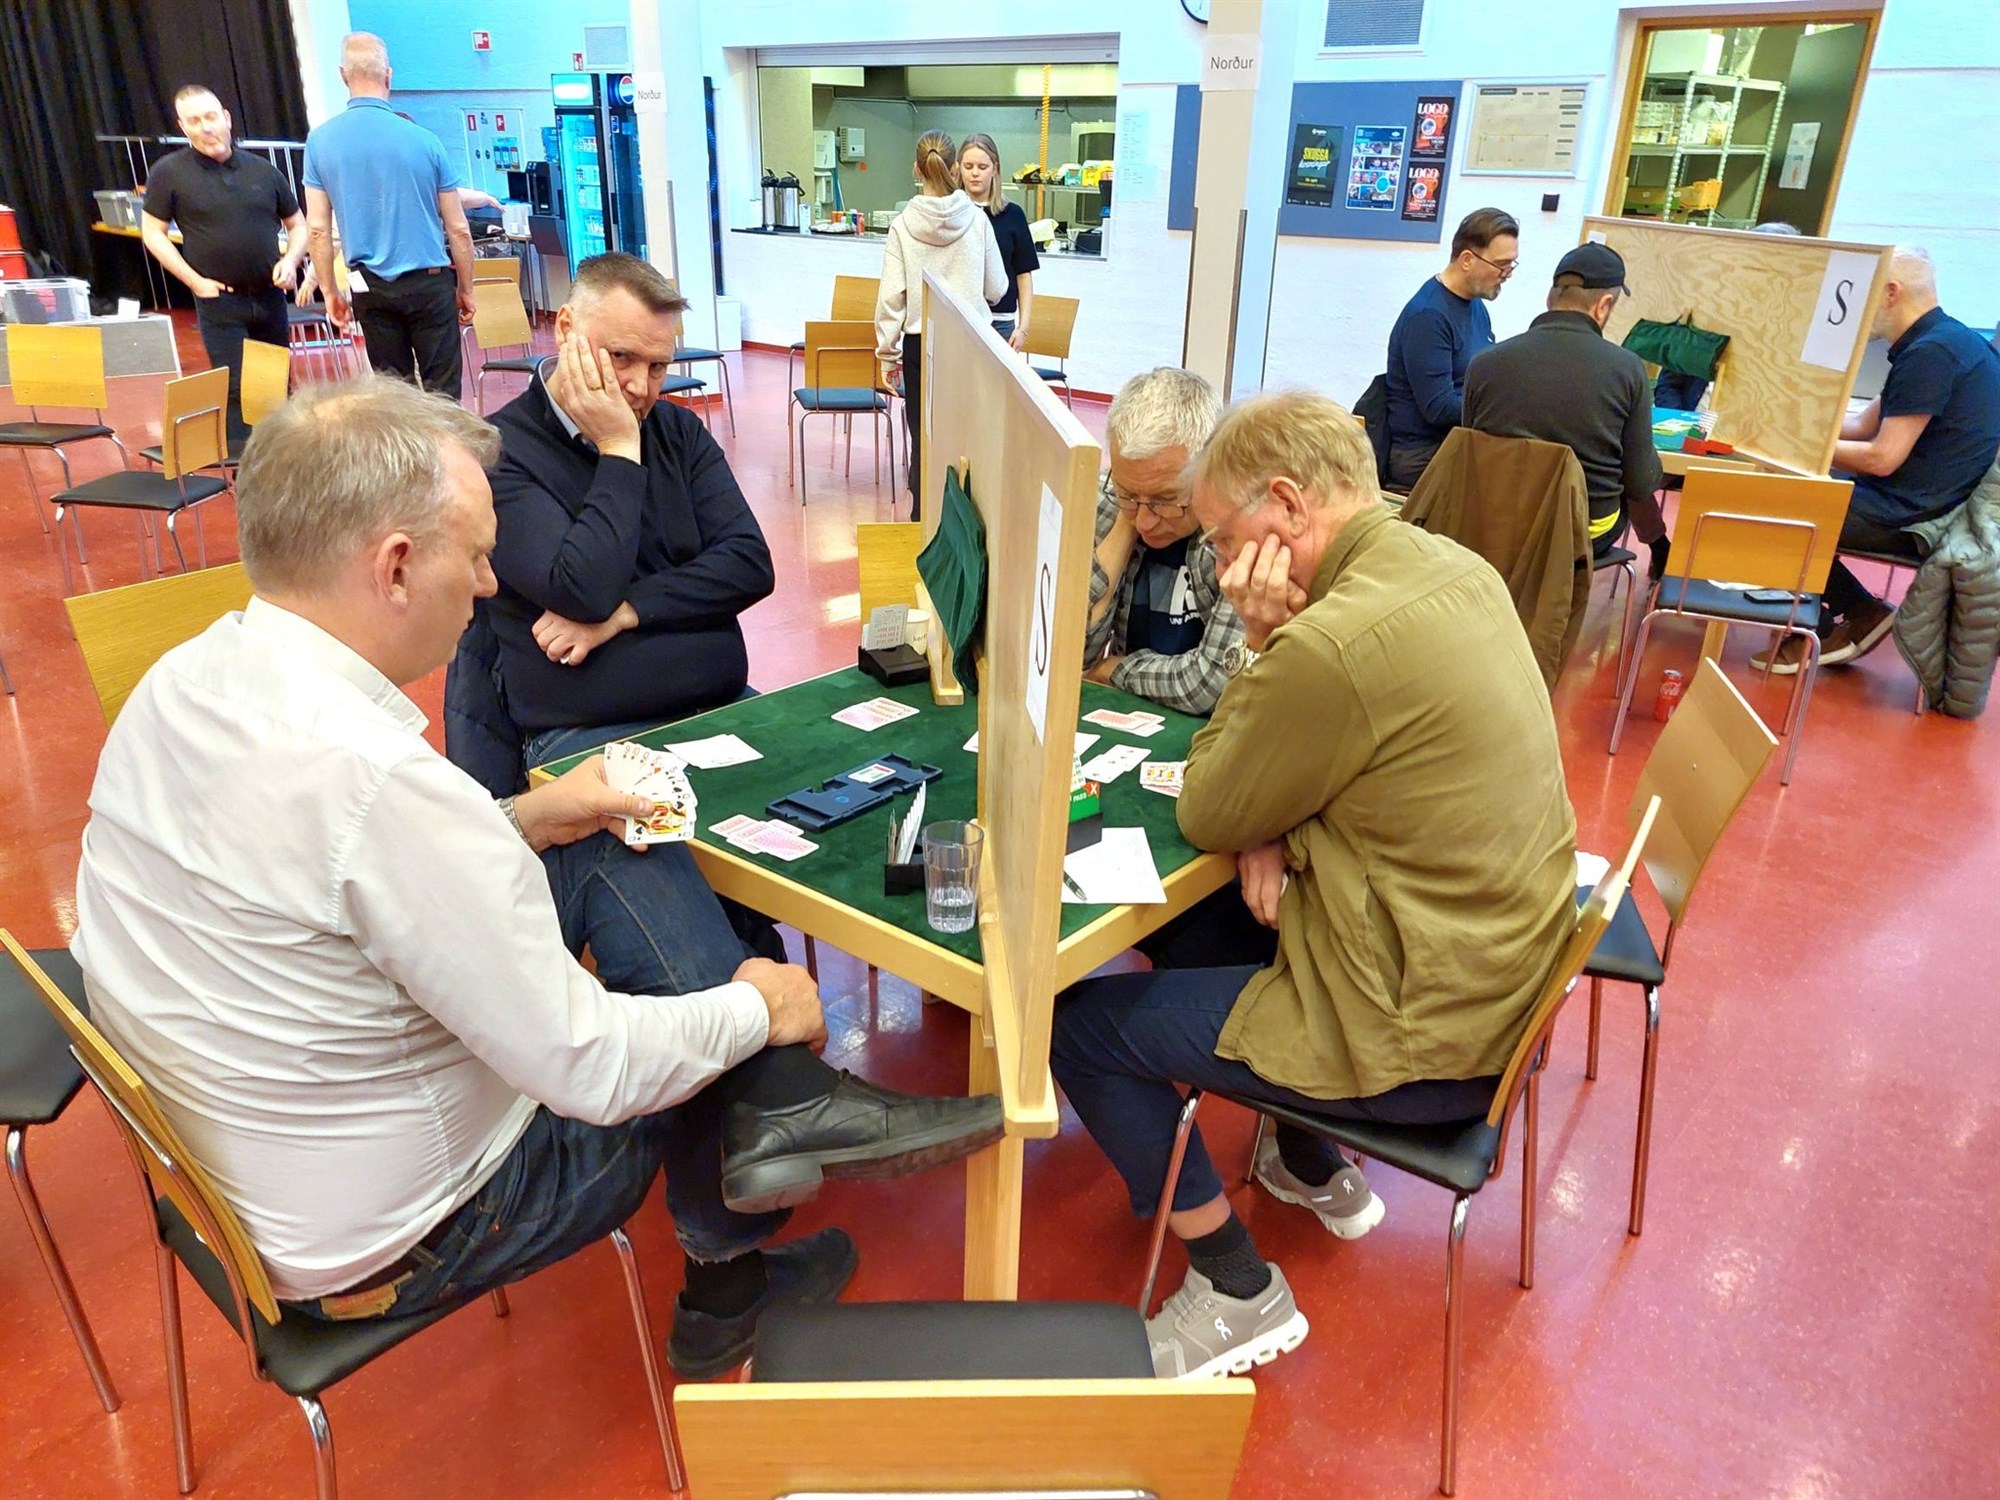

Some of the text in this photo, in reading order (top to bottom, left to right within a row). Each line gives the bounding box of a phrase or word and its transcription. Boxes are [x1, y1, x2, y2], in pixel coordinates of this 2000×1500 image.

[1210, 56, 1254, 70] Norður
[637, 89, 662, 100] Norður
[1827, 279, 1853, 325] S
[1035, 562, 1051, 676] S
[1073, 791, 1087, 802] PASS
